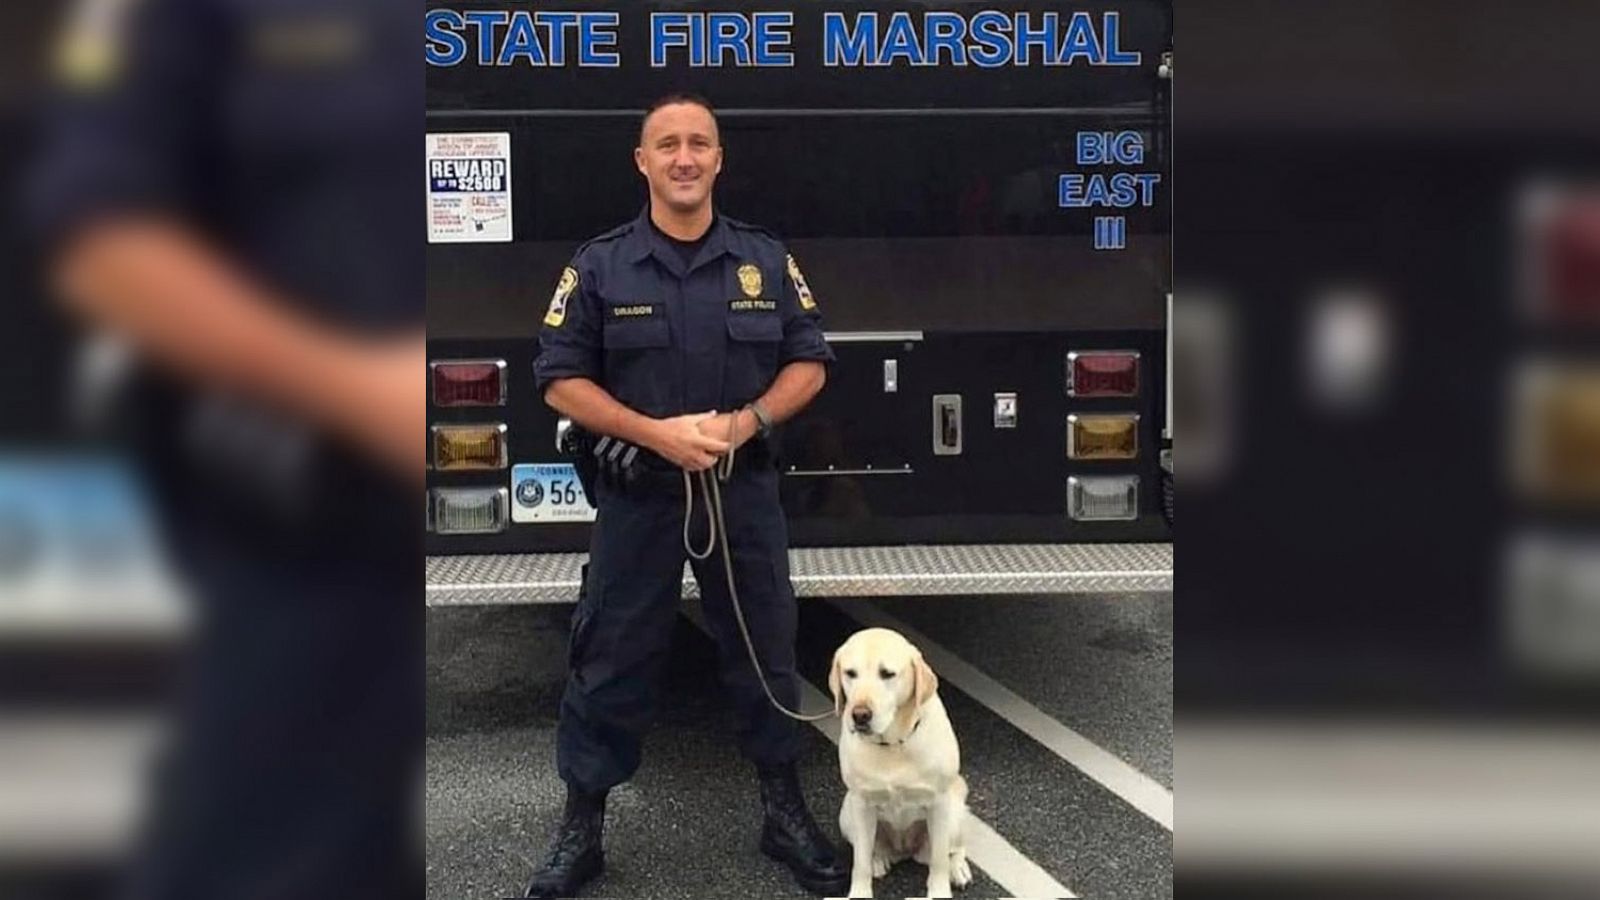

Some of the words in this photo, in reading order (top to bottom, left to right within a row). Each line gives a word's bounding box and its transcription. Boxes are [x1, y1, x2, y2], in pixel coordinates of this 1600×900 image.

[426, 9, 620, 67] STATE
[650, 11, 795, 67] FIRE
[823, 10, 1142, 67] MARSHAL
[1077, 131, 1144, 165] BIG
[432, 160, 504, 178] REWARD
[458, 177, 501, 191] $2500
[1059, 172, 1161, 208] EAST
[1094, 216, 1126, 250] III
[731, 300, 753, 310] STATE
